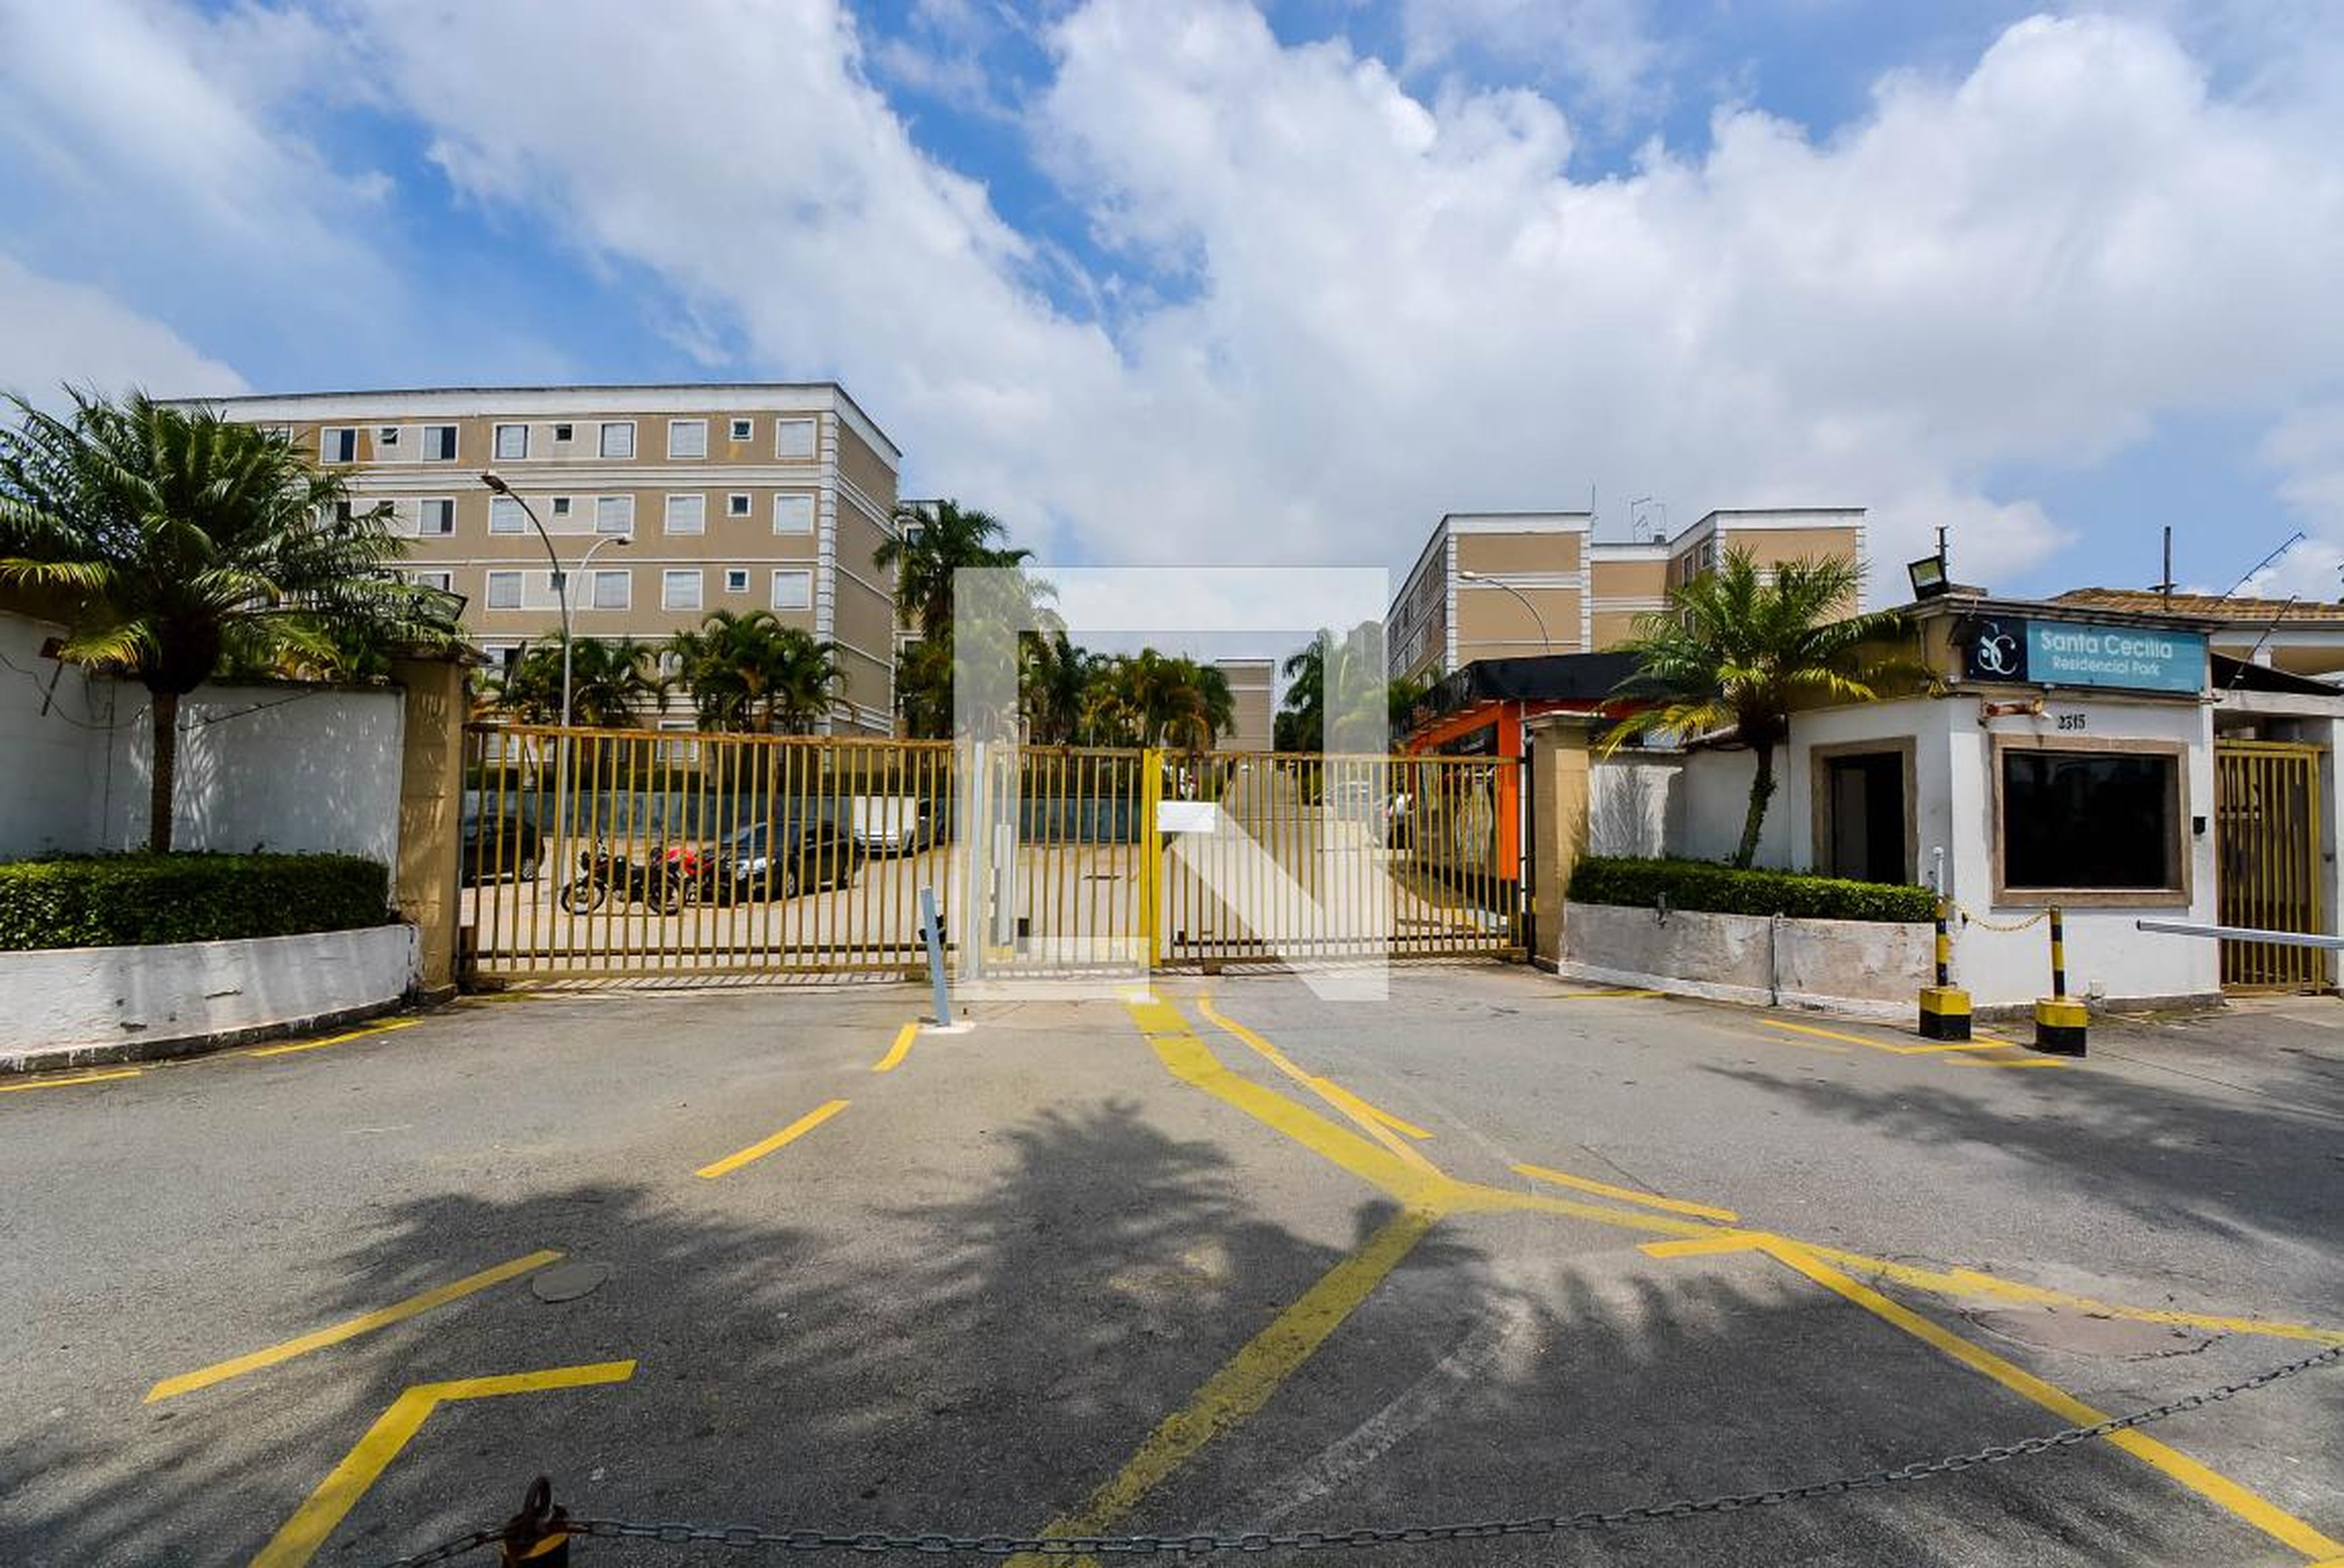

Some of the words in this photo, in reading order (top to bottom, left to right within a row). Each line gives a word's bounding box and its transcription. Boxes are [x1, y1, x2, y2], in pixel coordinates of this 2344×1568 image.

[2040, 629, 2099, 654] Santa
[2052, 655, 2129, 673] Residencial
[2132, 660, 2160, 677] Park
[2058, 713, 2086, 729] 2315
